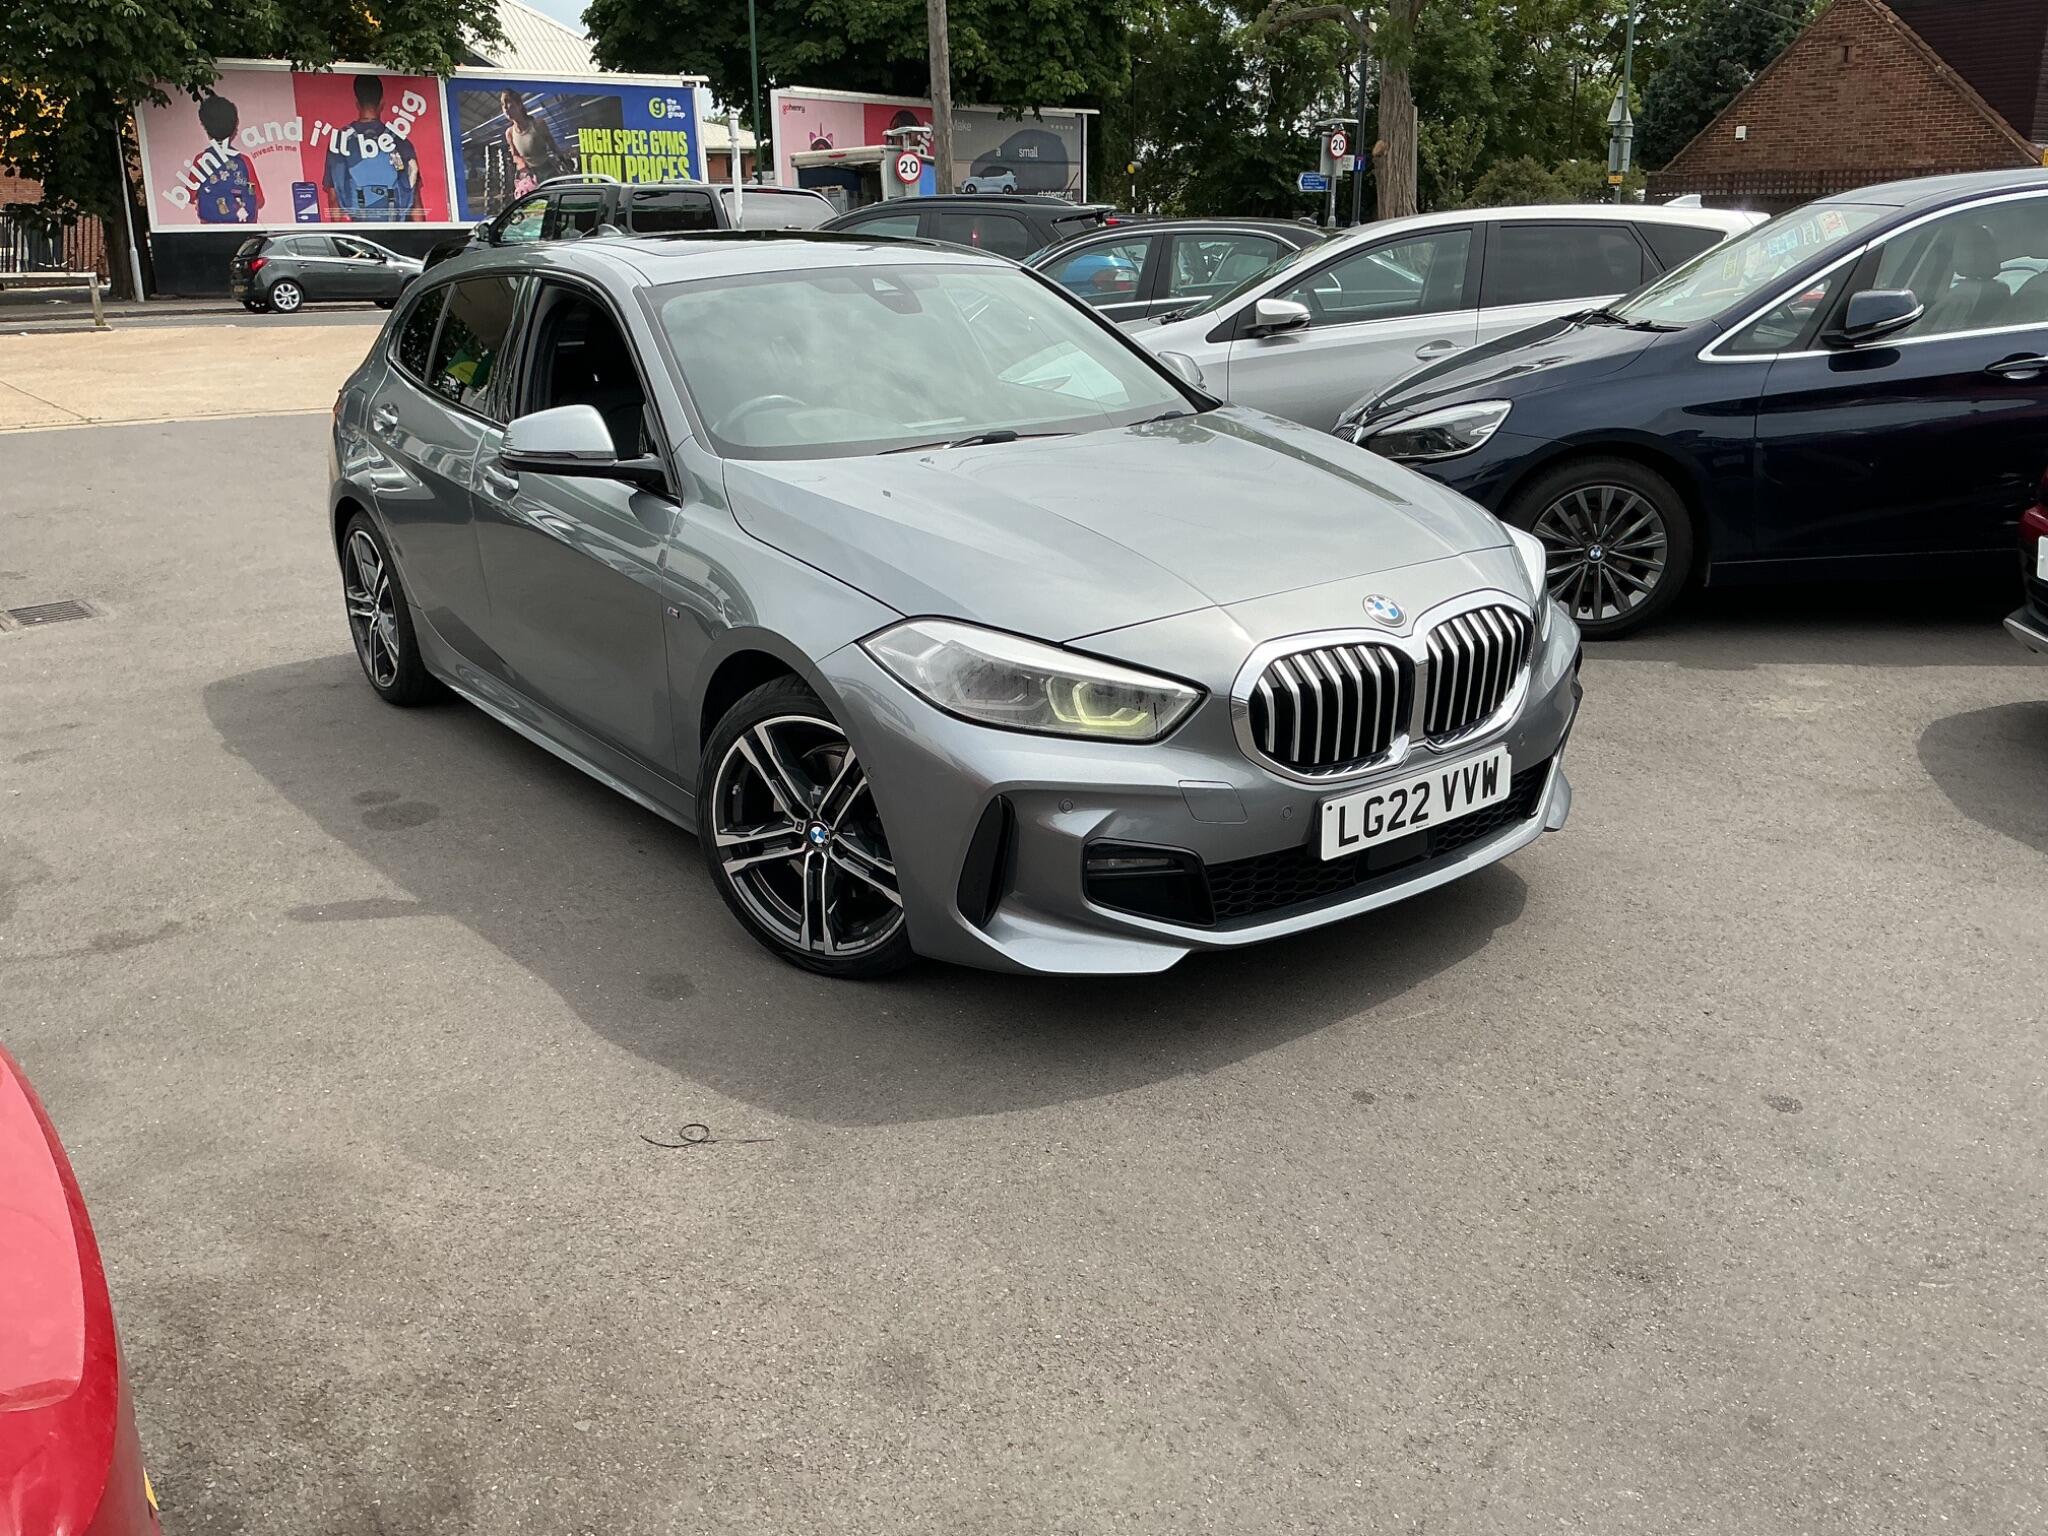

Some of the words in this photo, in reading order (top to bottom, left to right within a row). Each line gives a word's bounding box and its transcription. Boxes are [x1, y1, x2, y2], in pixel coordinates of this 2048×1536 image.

[162, 136, 240, 210] blink
[240, 116, 303, 148] and
[310, 120, 355, 156] i'll
[357, 133, 397, 159] be
[385, 89, 427, 140] big
[251, 145, 274, 160] invest
[578, 128, 613, 154] HIGH
[613, 129, 649, 155] SPEC
[649, 130, 689, 156] GYMS
[995, 147, 1001, 157] a
[1018, 146, 1038, 158] small
[1332, 139, 1345, 151] 20
[580, 154, 622, 184] LOW
[624, 155, 691, 184] PRICES
[900, 161, 918, 174] 20
[1338, 781, 1431, 848] LG22
[1441, 755, 1499, 813] VVW
